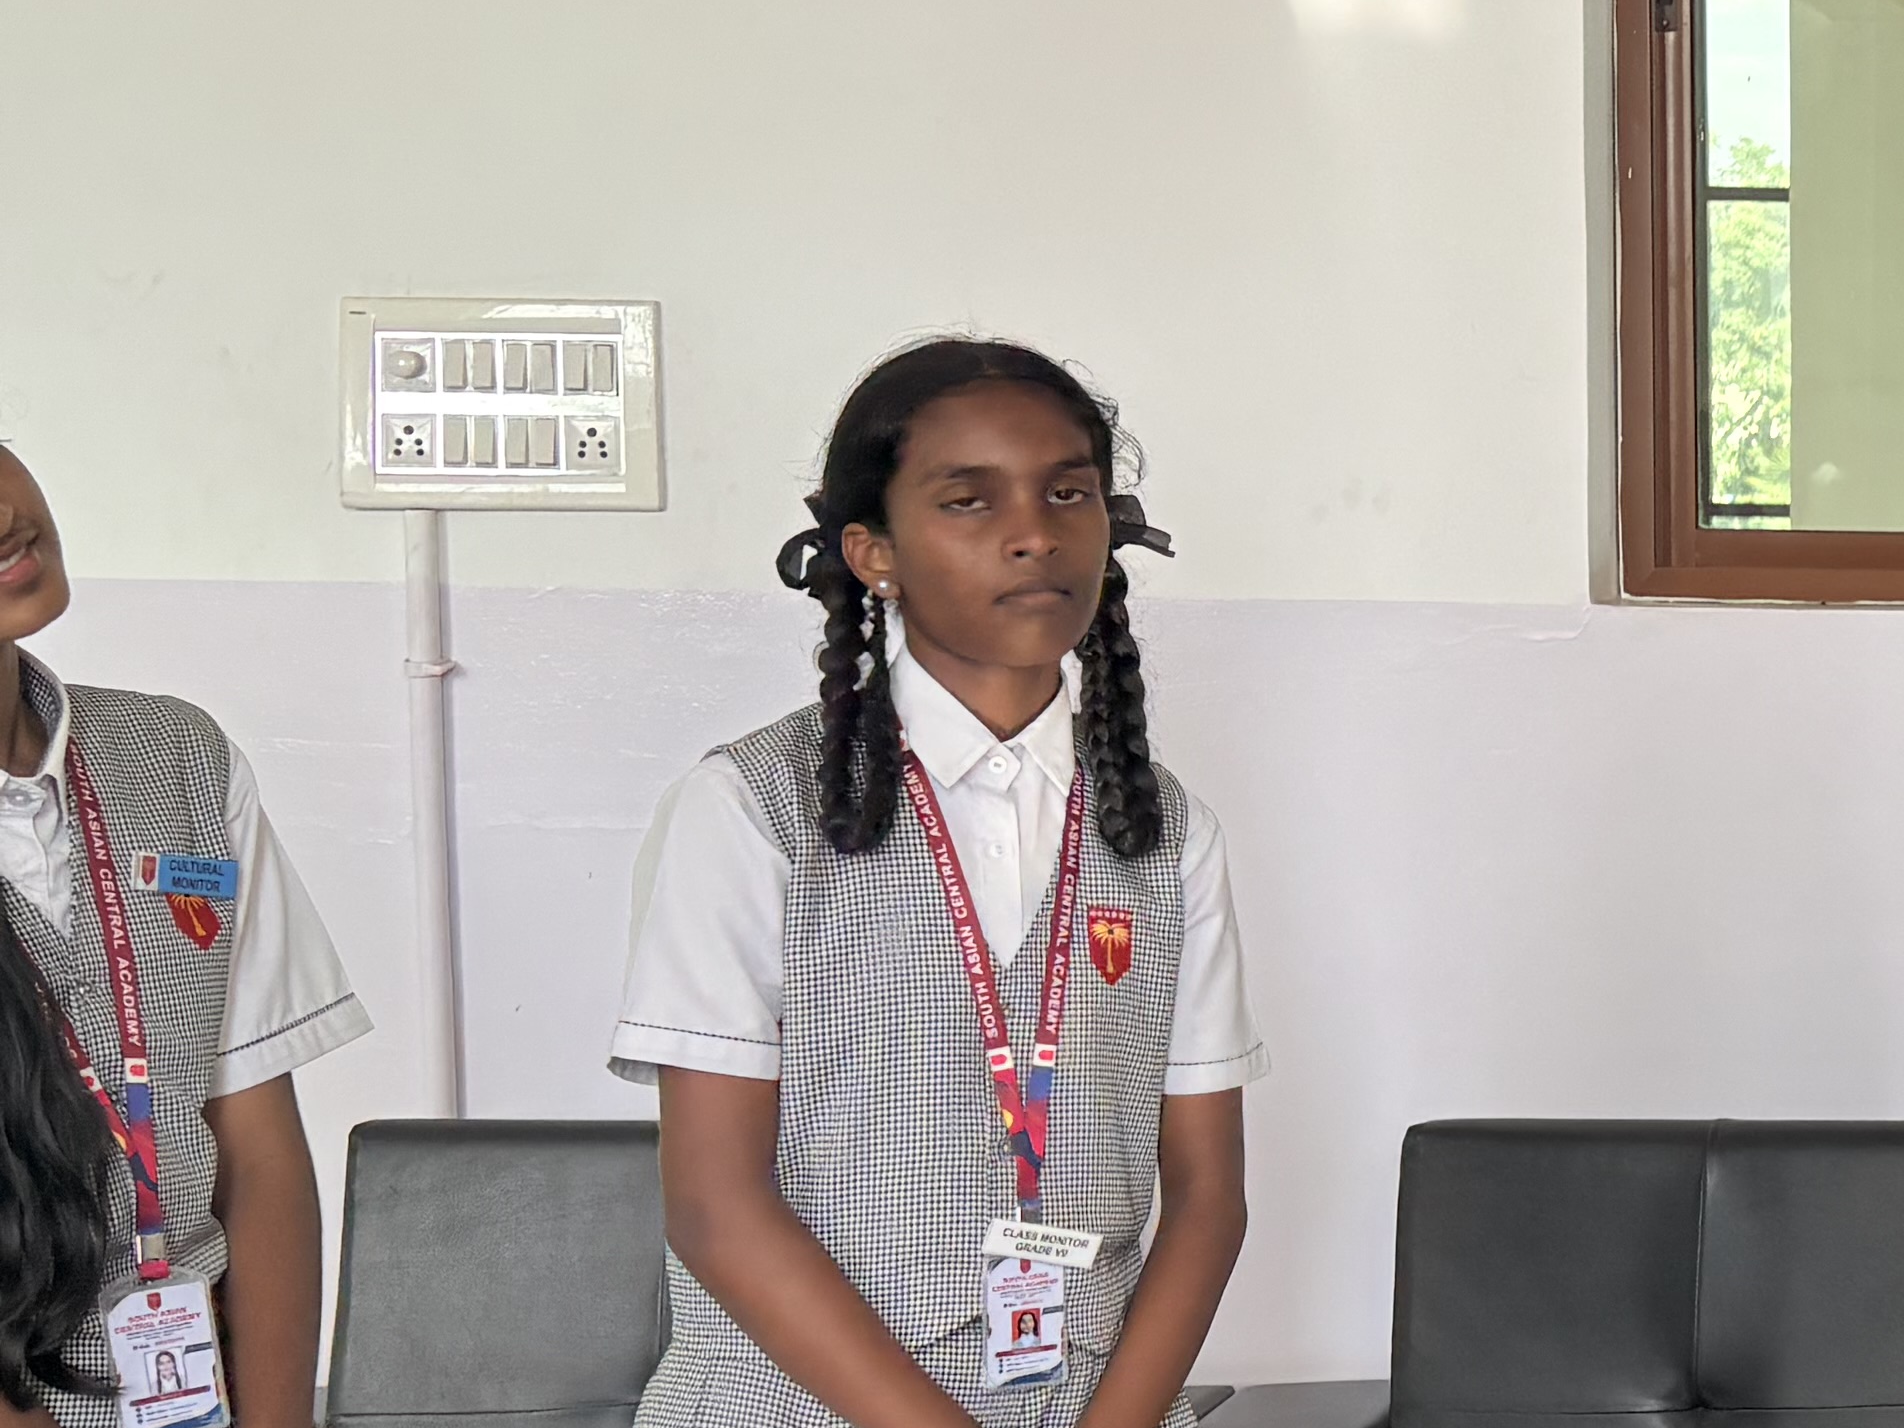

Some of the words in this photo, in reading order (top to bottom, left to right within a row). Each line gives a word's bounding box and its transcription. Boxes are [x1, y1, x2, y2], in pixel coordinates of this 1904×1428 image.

[903, 764, 942, 838] ACADEMY
[169, 860, 224, 877] CULTURAL
[1066, 820, 1081, 869] ASIAN
[70, 742, 93, 802] SOUTH
[86, 807, 108, 860] ASIAN
[99, 868, 125, 949] CENTRAL
[116, 956, 141, 1047] ACADEMY
[172, 876, 221, 893] MONITOR
[933, 844, 968, 919] CENTRAL
[1056, 874, 1075, 947] CENTRAL
[958, 925, 985, 975] ASIAN
[975, 982, 998, 1039] SOUTH
[1046, 953, 1067, 1034] ACADEMY
[1003, 1228, 1038, 1242] CLASS
[1040, 1233, 1090, 1248] MONITOR
[1015, 1242, 1053, 1255] GRADE
